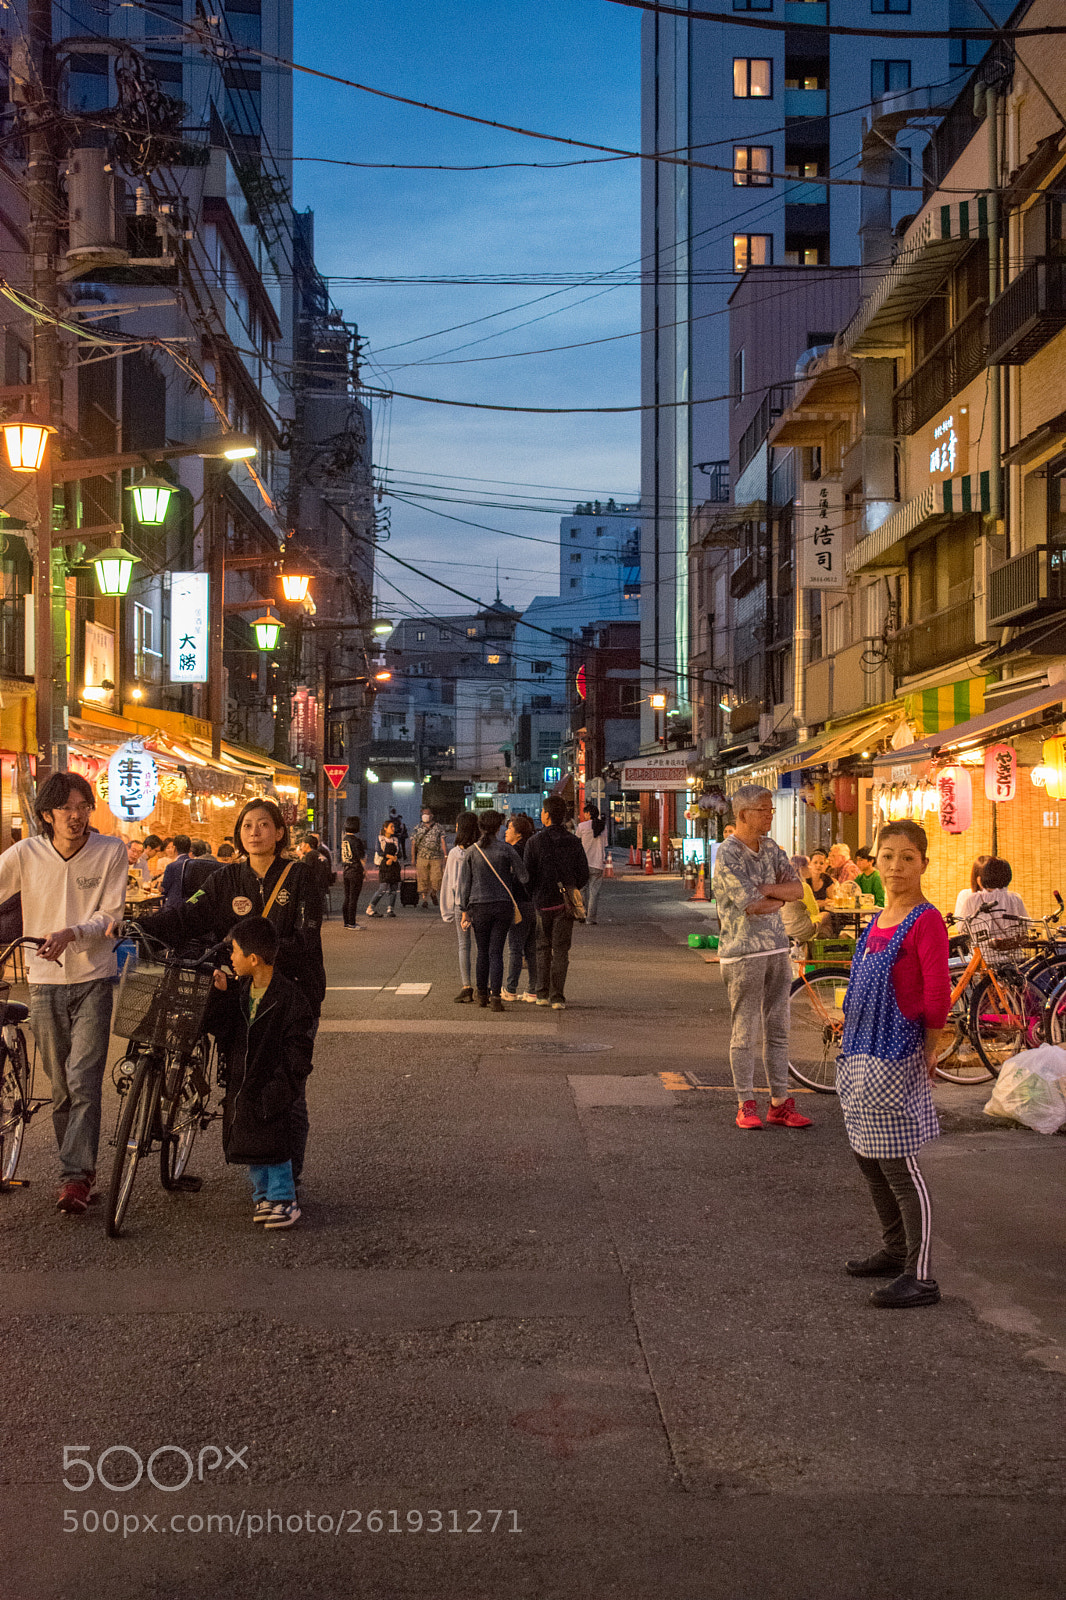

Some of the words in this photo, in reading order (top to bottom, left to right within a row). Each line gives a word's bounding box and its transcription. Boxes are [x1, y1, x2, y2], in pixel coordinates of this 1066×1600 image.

[819, 488, 829, 519] 居酒屋
[814, 525, 835, 571] 浩司
[179, 633, 197, 671] 大勝
[118, 758, 143, 815] 生ホッピー
[995, 751, 1012, 797] やきとり
[939, 777, 956, 827] 煮込み
